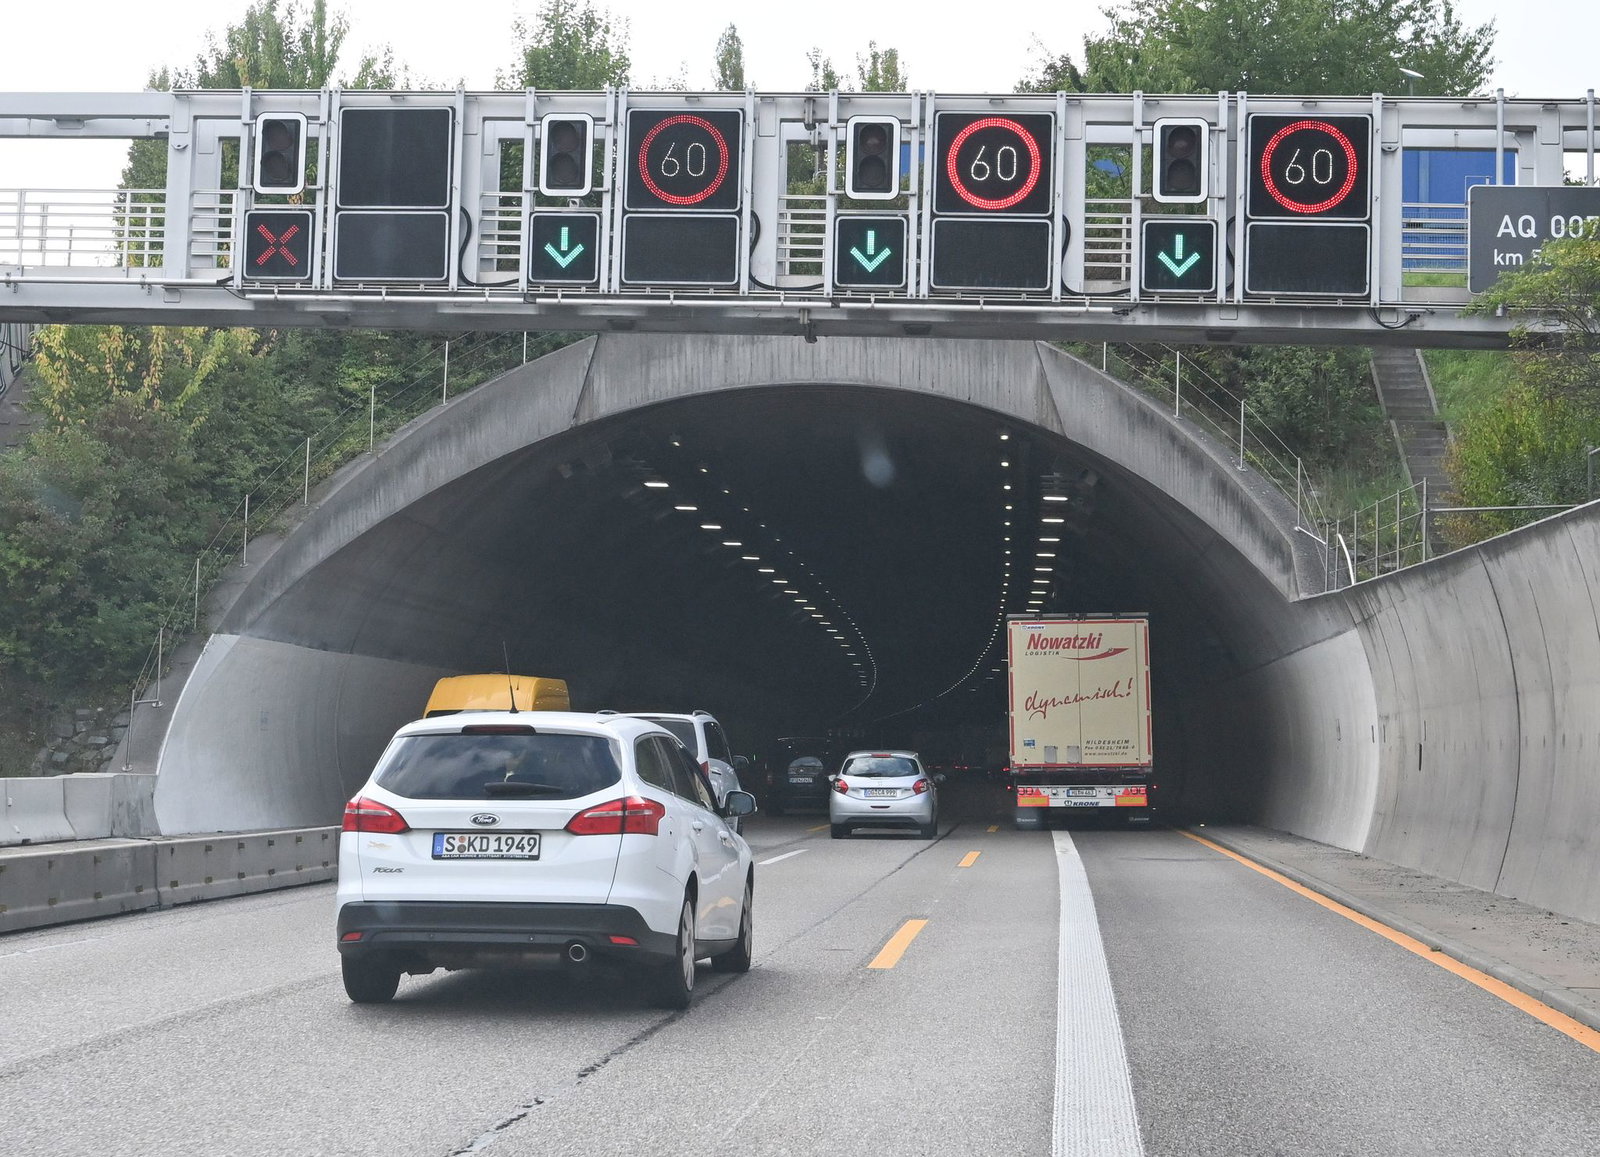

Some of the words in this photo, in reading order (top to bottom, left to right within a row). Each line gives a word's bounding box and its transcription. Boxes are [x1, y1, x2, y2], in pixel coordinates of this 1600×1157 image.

[661, 142, 706, 177] 60
[970, 145, 1017, 181] 60
[1285, 148, 1333, 184] 60
[1496, 214, 1538, 239] AQ
[1493, 248, 1523, 266] km
[1027, 633, 1103, 650] Nowatzki
[1025, 677, 1133, 720] dynamisch!
[445, 836, 456, 853] S
[467, 836, 490, 853] KD
[493, 836, 538, 853] 1949
